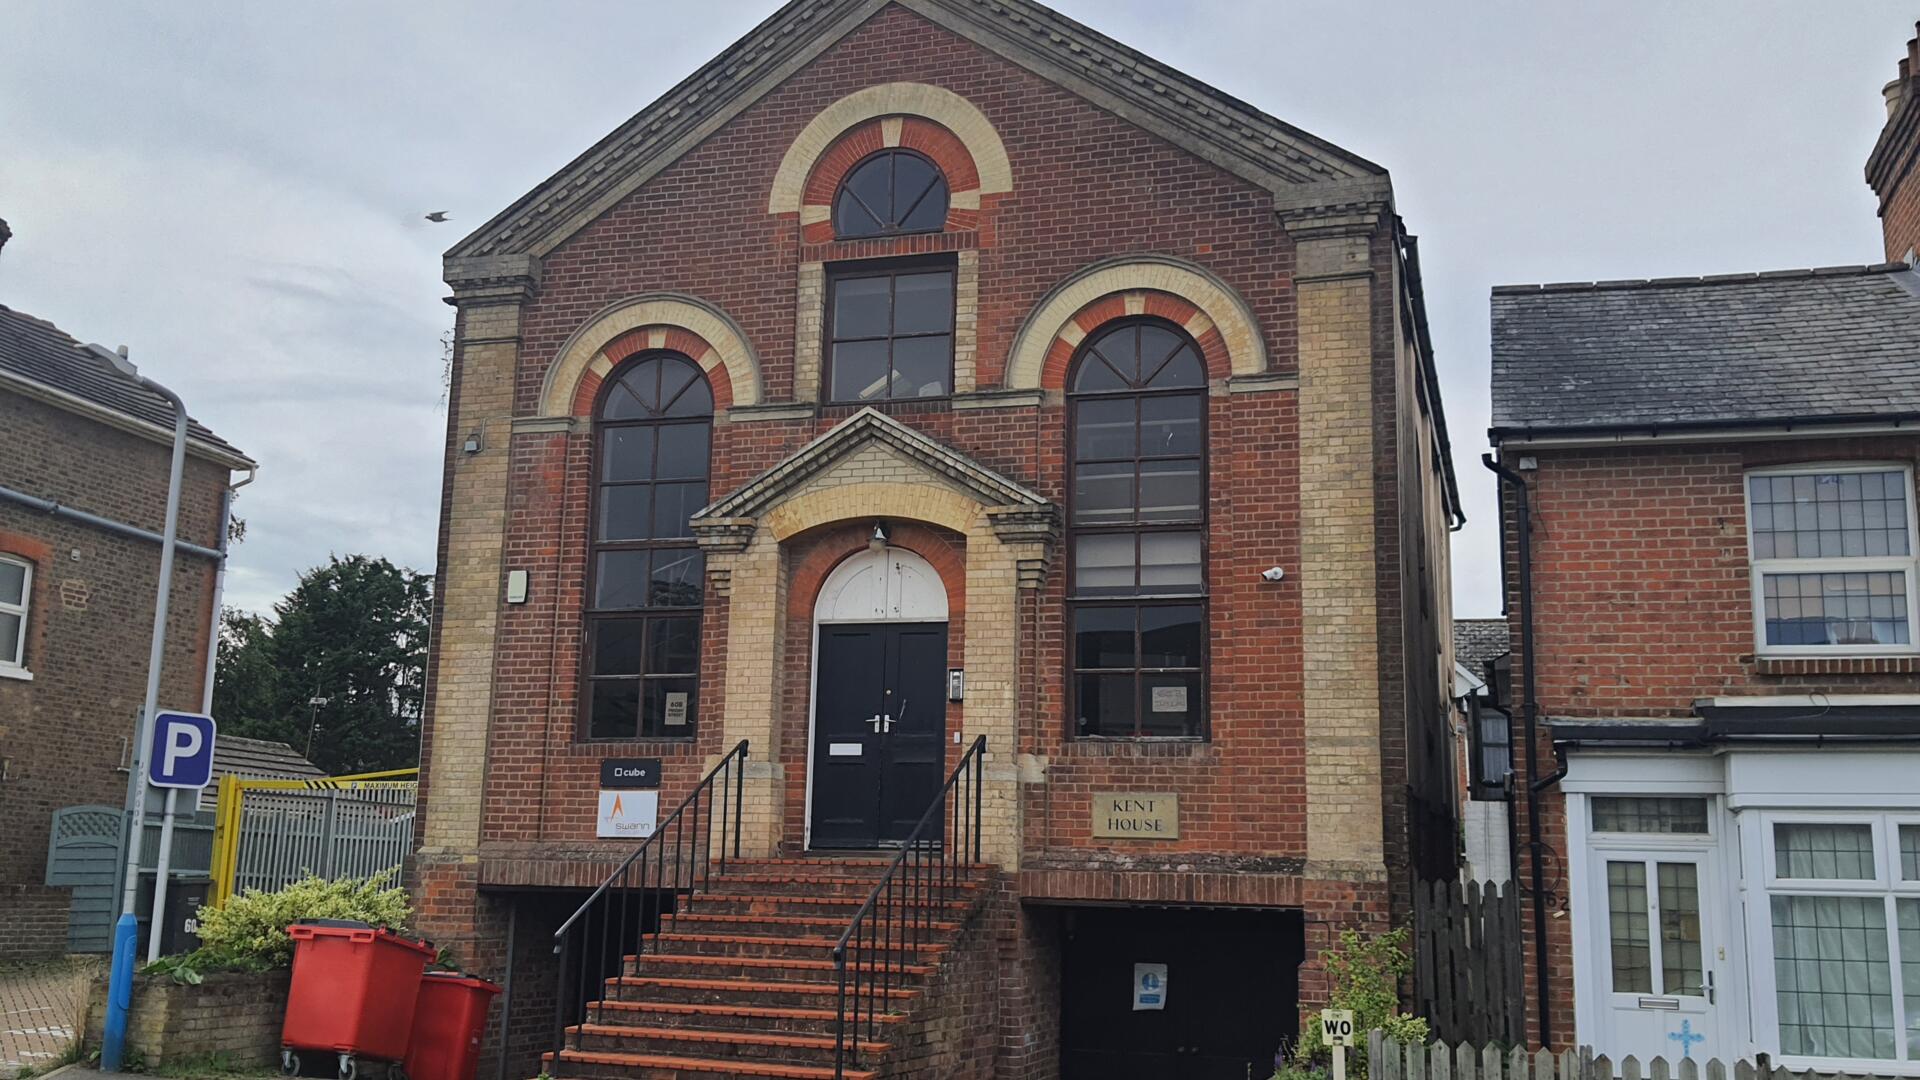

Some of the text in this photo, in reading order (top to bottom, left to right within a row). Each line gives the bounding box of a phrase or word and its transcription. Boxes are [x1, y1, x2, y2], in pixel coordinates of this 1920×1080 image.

[162, 721, 203, 777] P
[623, 767, 646, 777] cube
[1113, 799, 1156, 812] KENT
[1108, 818, 1162, 832] HOUSE
[1546, 892, 1570, 911] 62
[1324, 1019, 1351, 1036] WO
